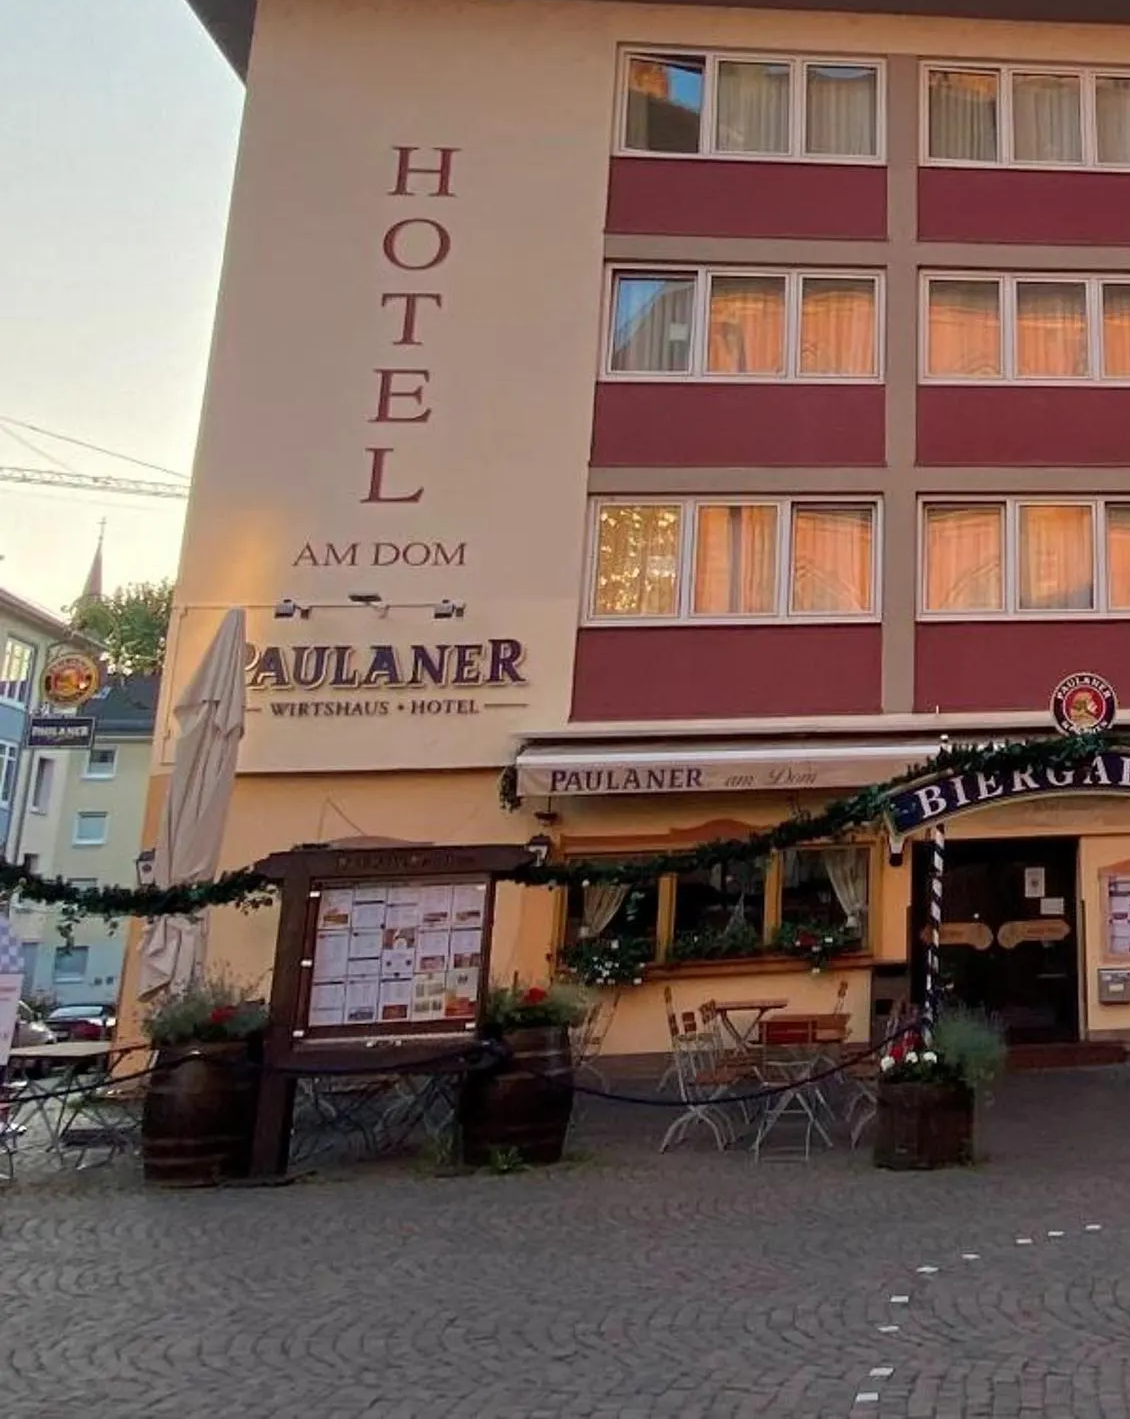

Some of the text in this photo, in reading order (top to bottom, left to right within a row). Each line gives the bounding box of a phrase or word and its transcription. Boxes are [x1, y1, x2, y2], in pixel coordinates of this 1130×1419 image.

[360, 146, 462, 503] HOTEL
[292, 542, 468, 567] AM DOM
[244, 638, 528, 690] AULANER
[270, 699, 480, 717] WIRTSHAUS HOTEL
[550, 768, 704, 791] PAULANER
